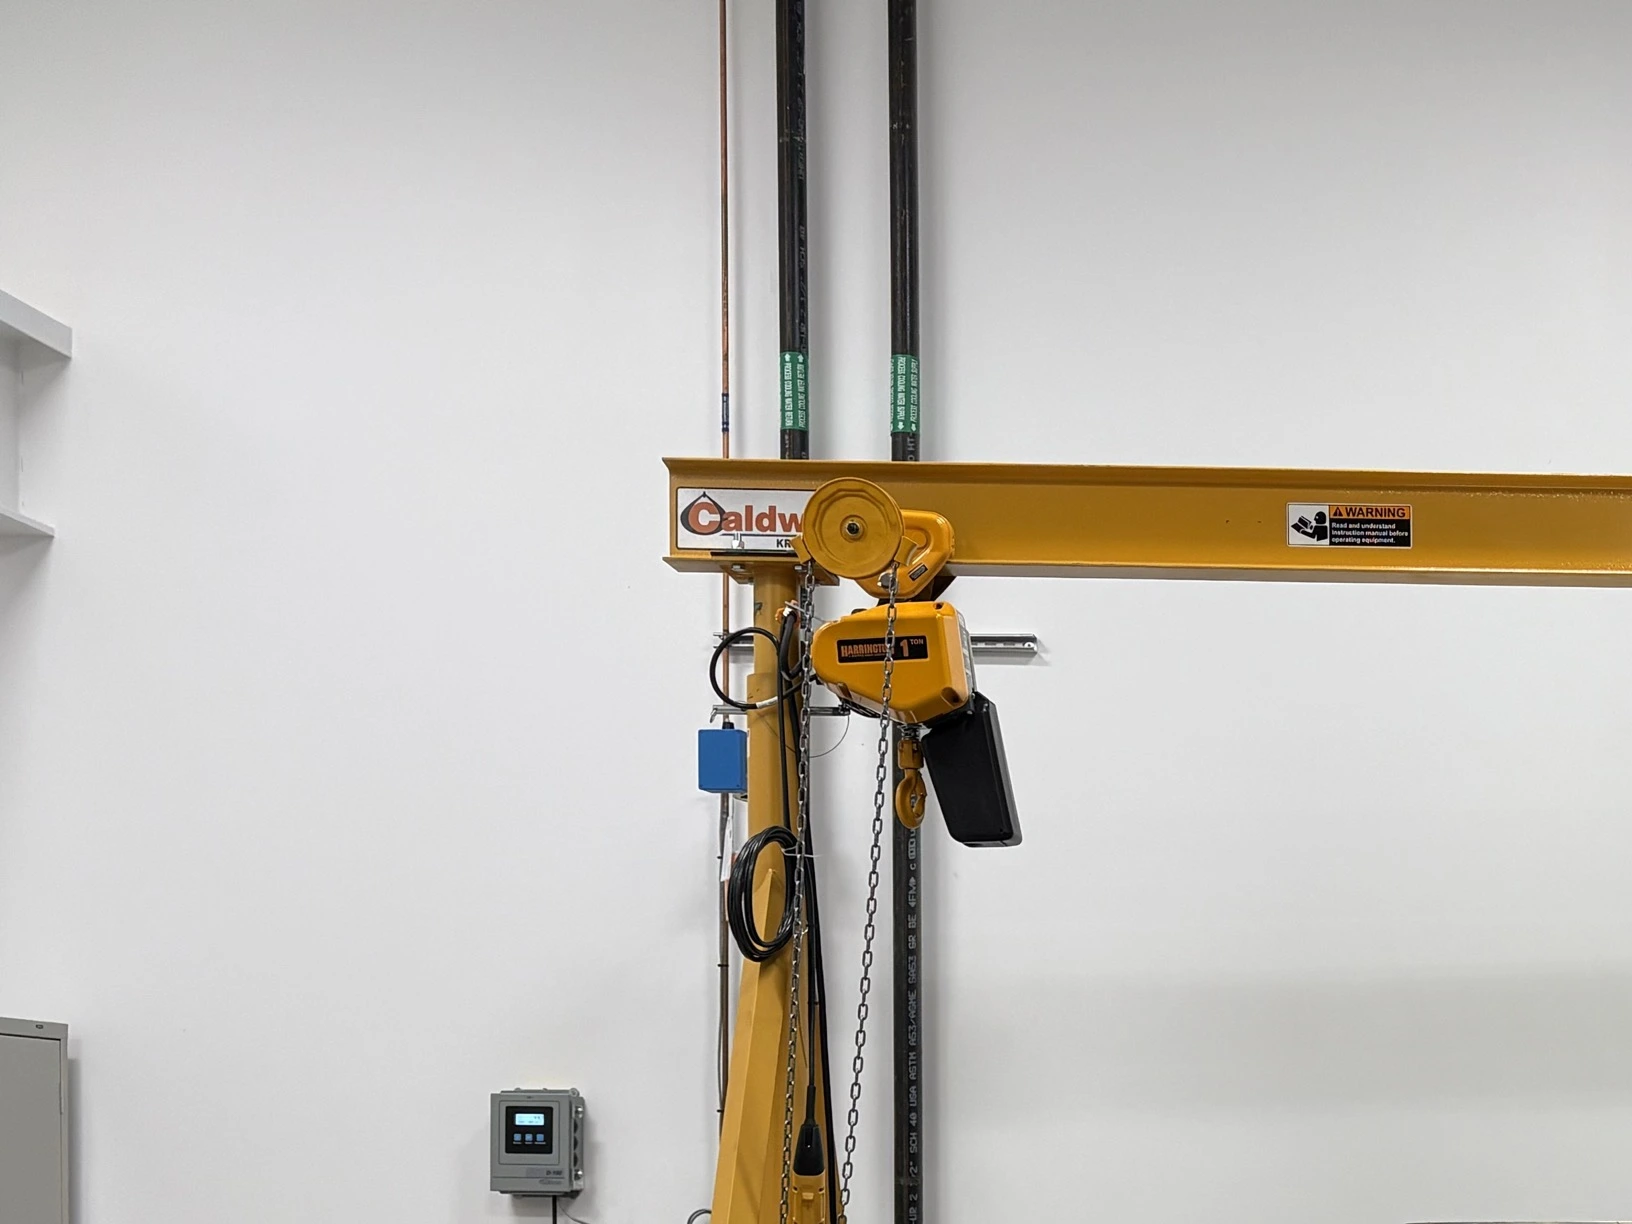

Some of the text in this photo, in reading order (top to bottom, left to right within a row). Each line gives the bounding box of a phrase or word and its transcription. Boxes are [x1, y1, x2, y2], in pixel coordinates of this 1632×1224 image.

[1345, 506, 1405, 518] WARNING
[900, 639, 909, 657] 1
[909, 990, 917, 1046] A53/ASME
[909, 1051, 917, 1080] ASTM
[909, 1086, 917, 1106] USA
[909, 1112, 917, 1126] 40
[909, 1132, 917, 1153] SCH
